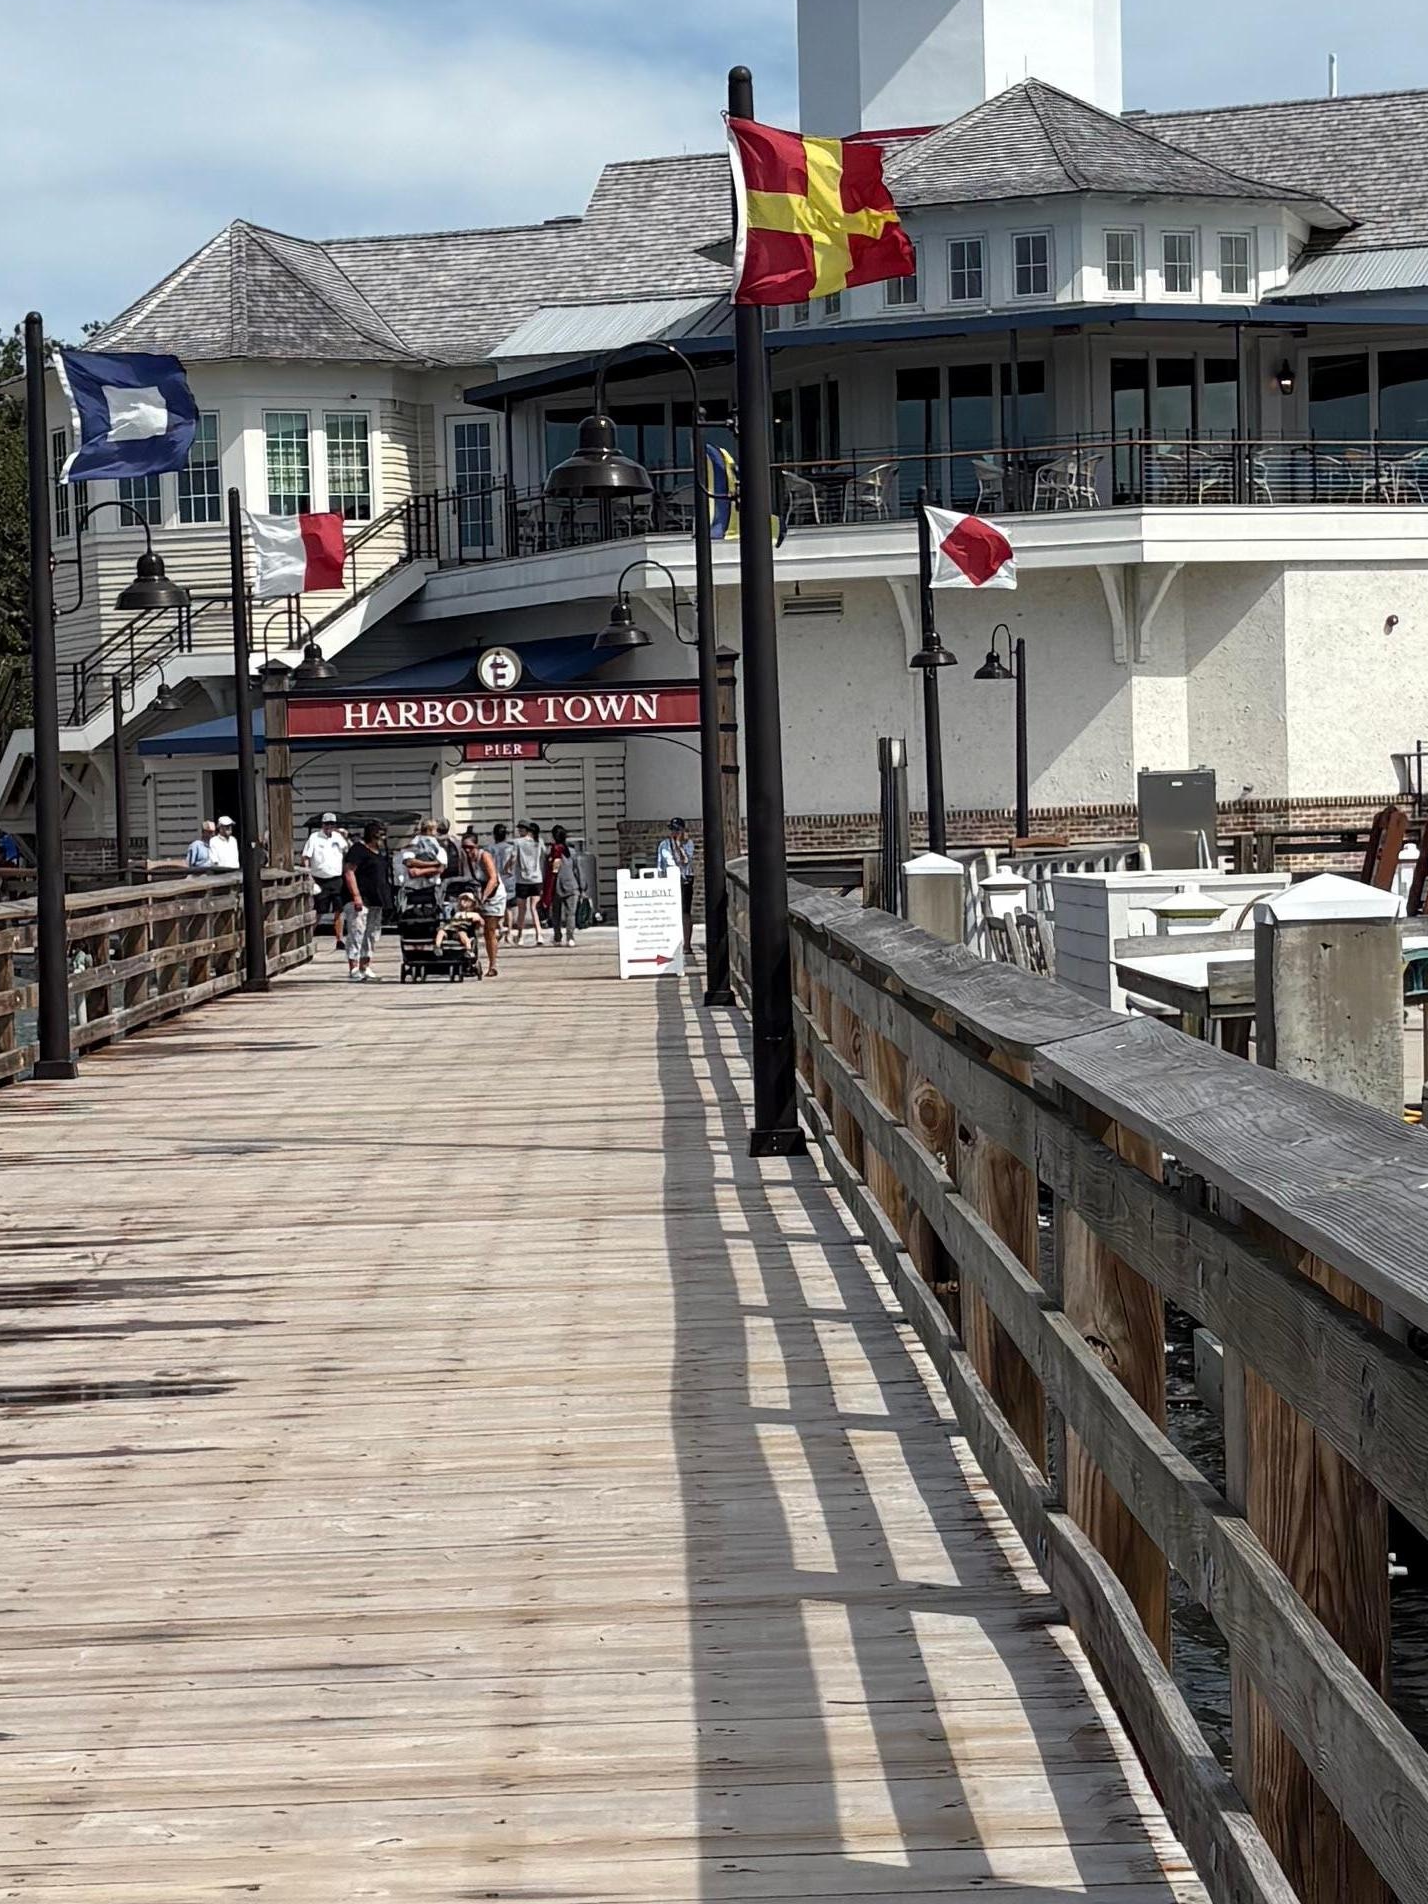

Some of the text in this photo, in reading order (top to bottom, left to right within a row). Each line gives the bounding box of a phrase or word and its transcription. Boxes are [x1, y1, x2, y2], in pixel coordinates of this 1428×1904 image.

[343, 694, 660, 728] HARBOUR TOWN
[484, 744, 523, 756] PIER
